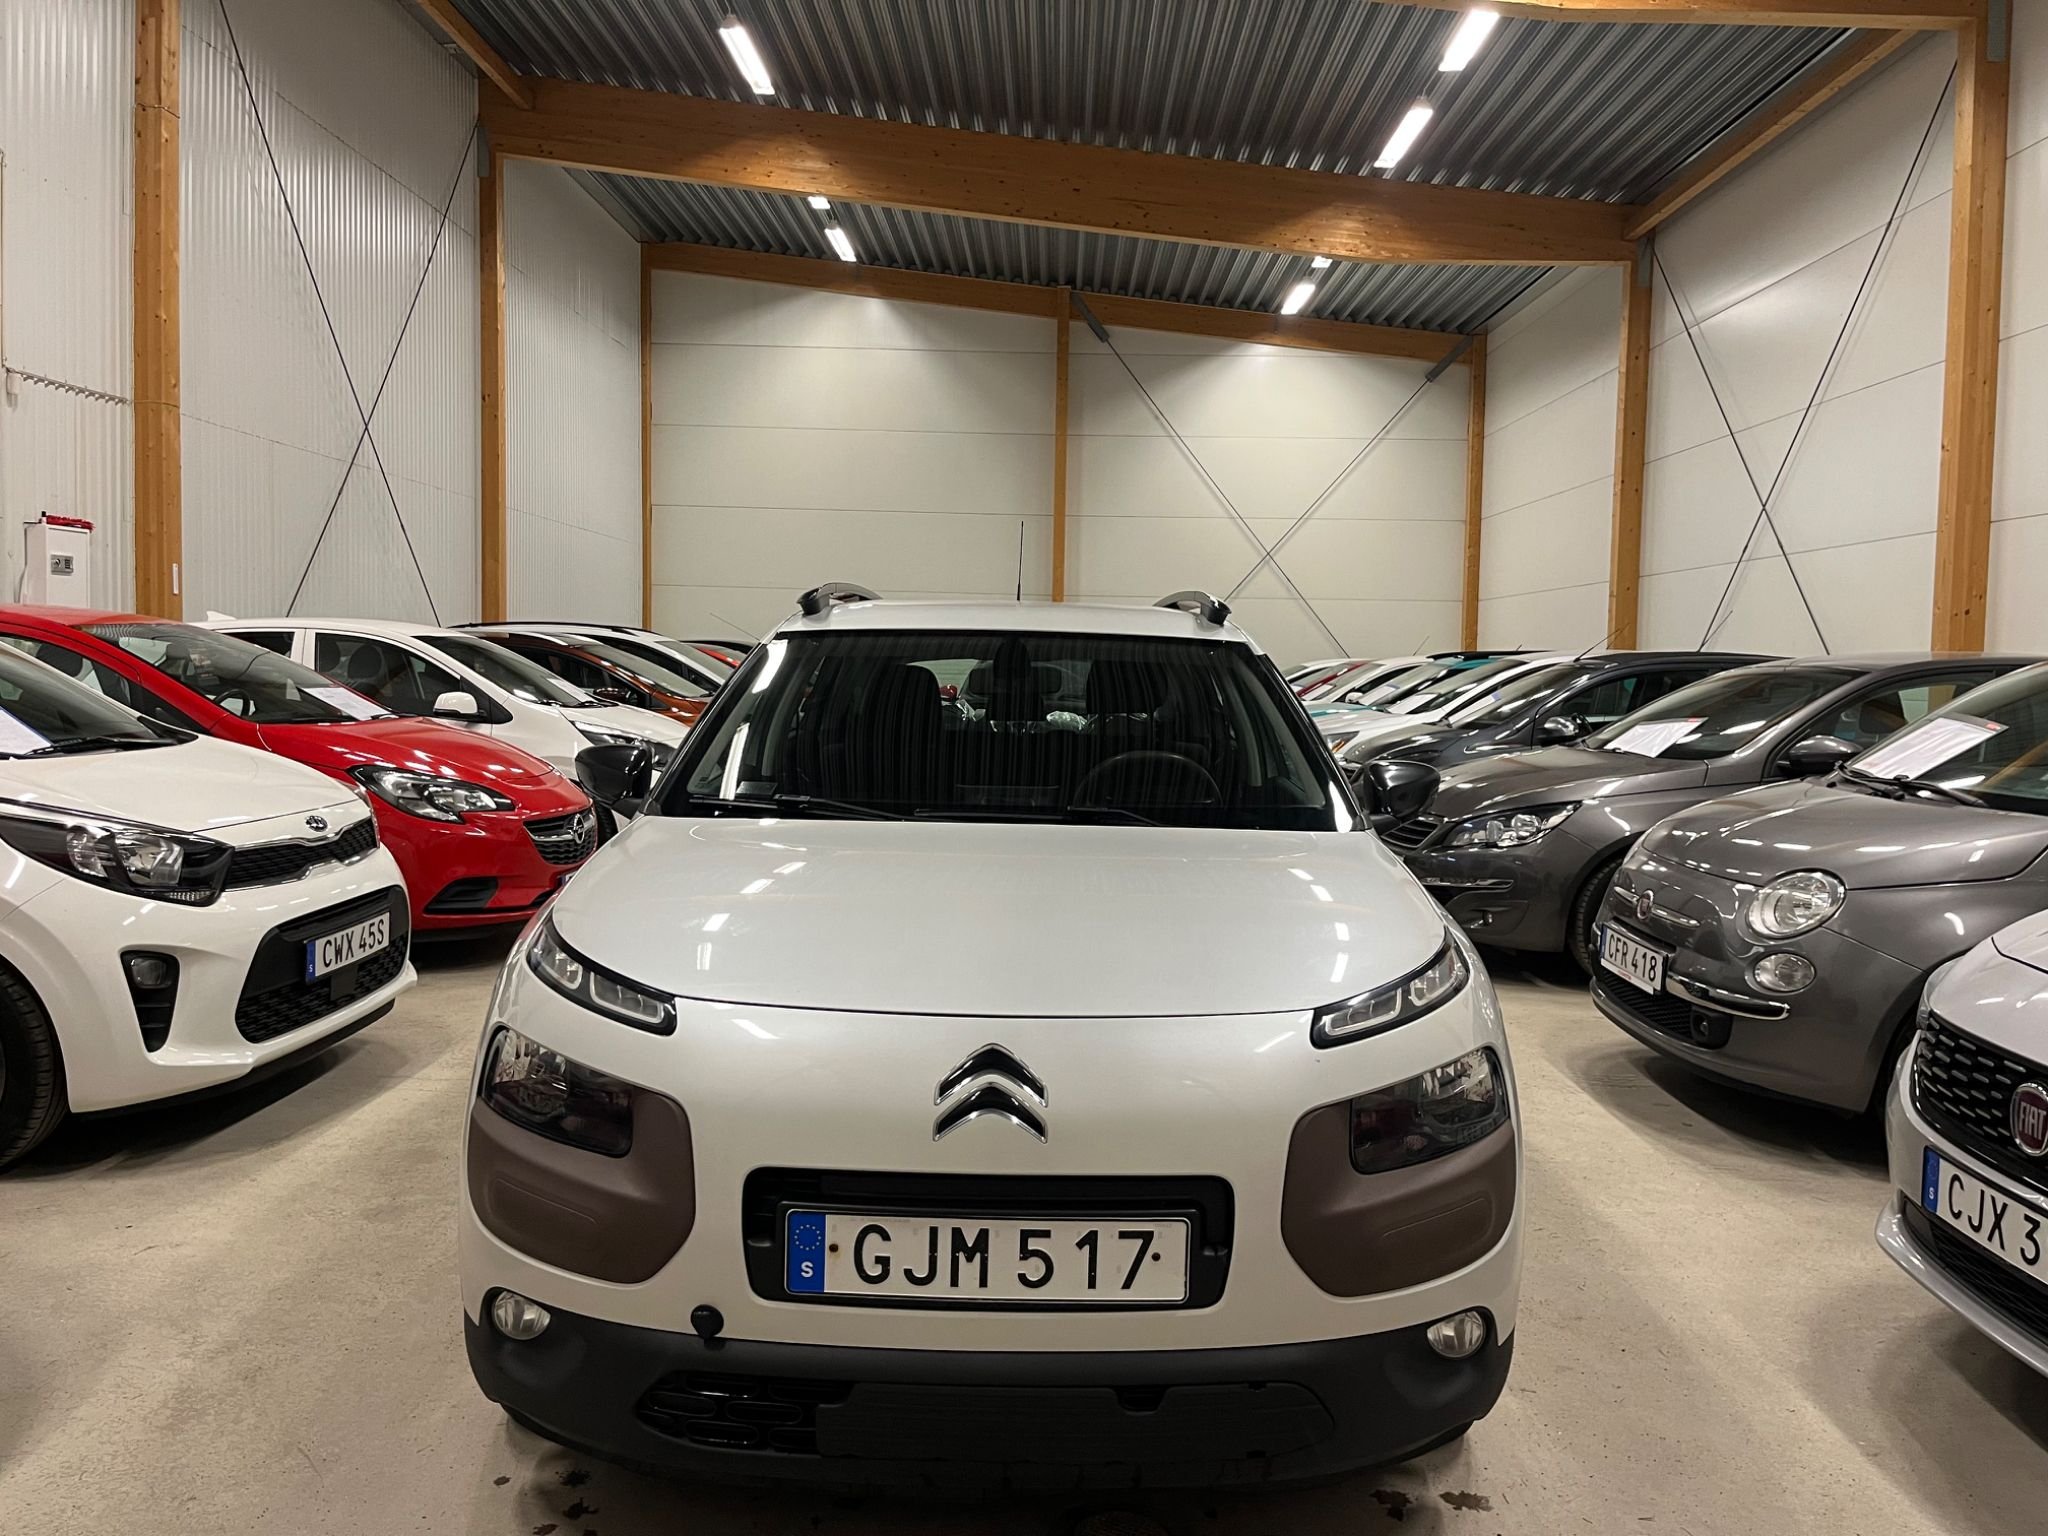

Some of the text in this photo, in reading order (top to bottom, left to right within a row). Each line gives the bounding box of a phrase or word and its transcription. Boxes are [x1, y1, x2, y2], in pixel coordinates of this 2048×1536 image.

[323, 919, 385, 968] CWX 45S
[1608, 934, 1657, 982] CFR 418
[2018, 1101, 2047, 1140] FIAT
[1928, 1187, 1935, 1200] S
[1948, 1173, 2008, 1251] CJX
[800, 1262, 814, 1278] S
[853, 1223, 1155, 1290] GJM 517
